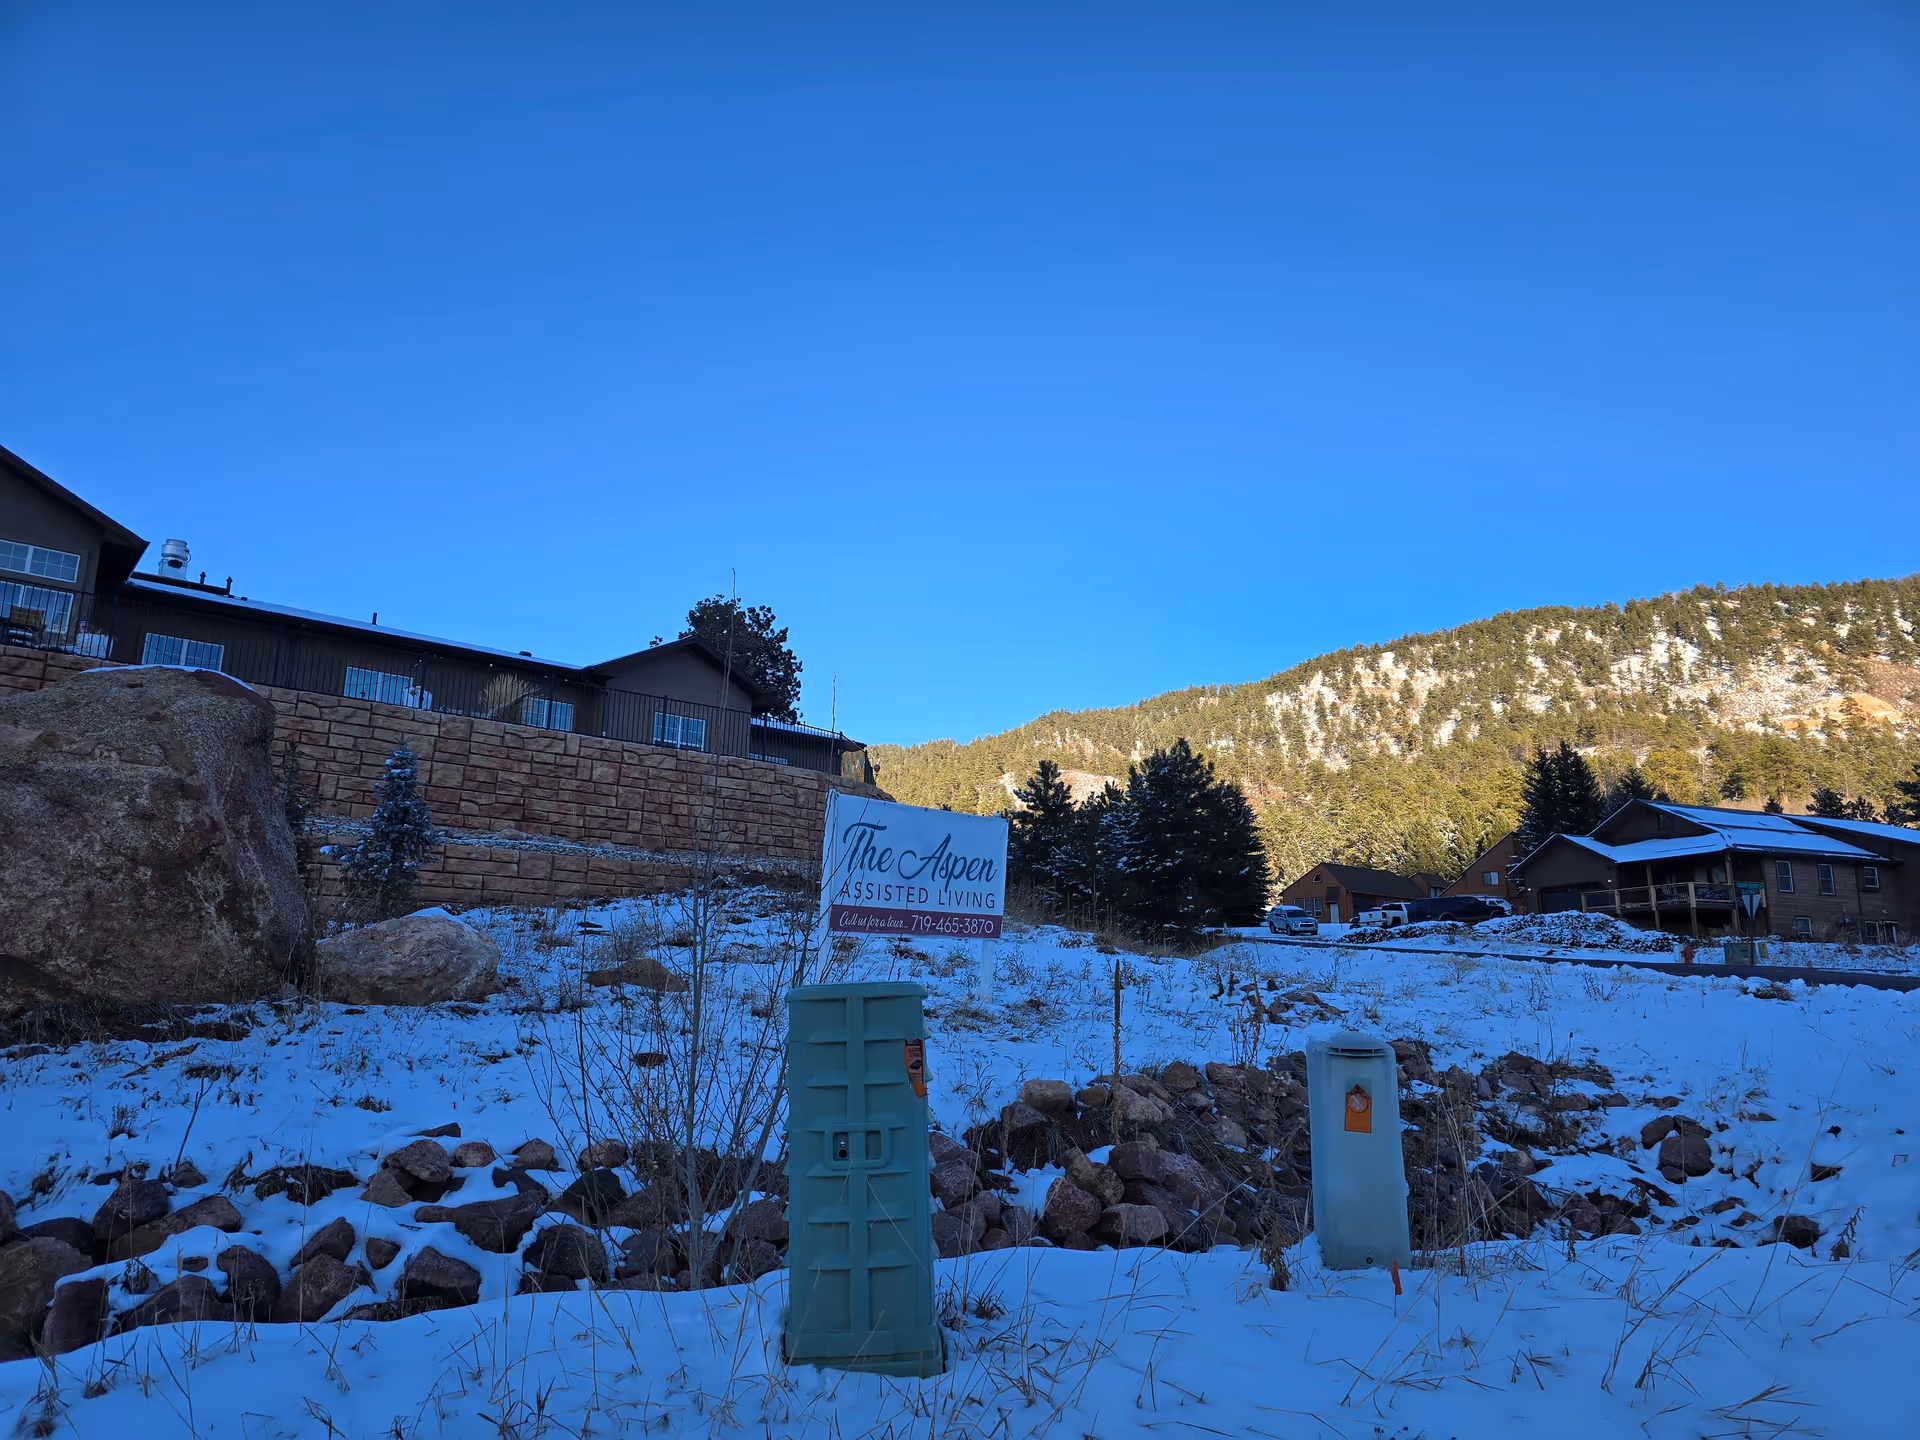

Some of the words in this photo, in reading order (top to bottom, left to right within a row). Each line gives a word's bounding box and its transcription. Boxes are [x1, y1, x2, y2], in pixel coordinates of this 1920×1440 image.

[843, 822, 894, 873] The
[898, 833, 997, 893] Aspen
[839, 881, 929, 904] ASSISTED
[938, 890, 996, 909] LIVING
[840, 911, 858, 926] Call
[858, 917, 867, 926] us
[866, 914, 880, 931] for
[880, 919, 887, 927] a
[911, 915, 994, 934] 719-465-3870
